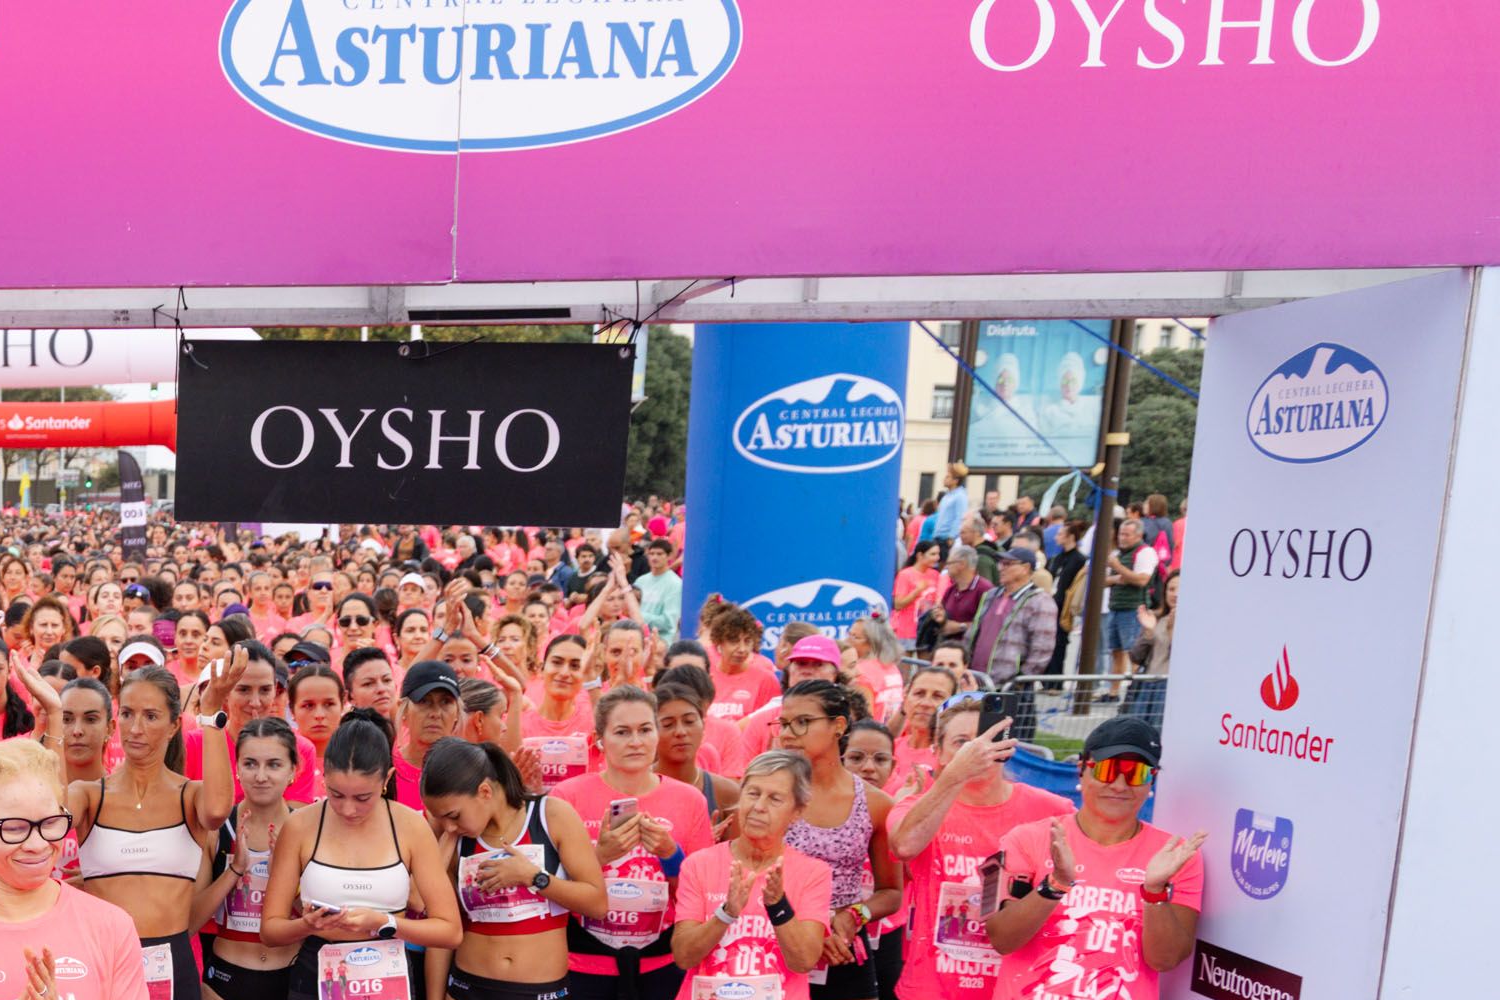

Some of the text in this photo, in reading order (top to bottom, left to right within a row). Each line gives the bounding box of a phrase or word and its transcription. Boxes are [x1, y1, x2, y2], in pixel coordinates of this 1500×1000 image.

[259, 0, 698, 87] ASTURIANA
[969, 0, 1381, 71] OYSHO
[1278, 379, 1374, 400] CENTRAL LECHERA
[25, 416, 92, 430] Santander
[746, 412, 899, 450] ASTURIANA
[779, 408, 846, 420] CENTRAL
[1254, 393, 1375, 436] ASTURIANA
[250, 405, 561, 472] OYSHO
[1230, 528, 1372, 581] OYSHO
[766, 612, 832, 623] CENTRAL
[1219, 713, 1334, 763] Santander
[1235, 828, 1288, 873] Marlene
[607, 910, 639, 924] 016
[1087, 919, 1122, 953] DE
[349, 979, 383, 994] 016
[958, 976, 985, 989] 2026
